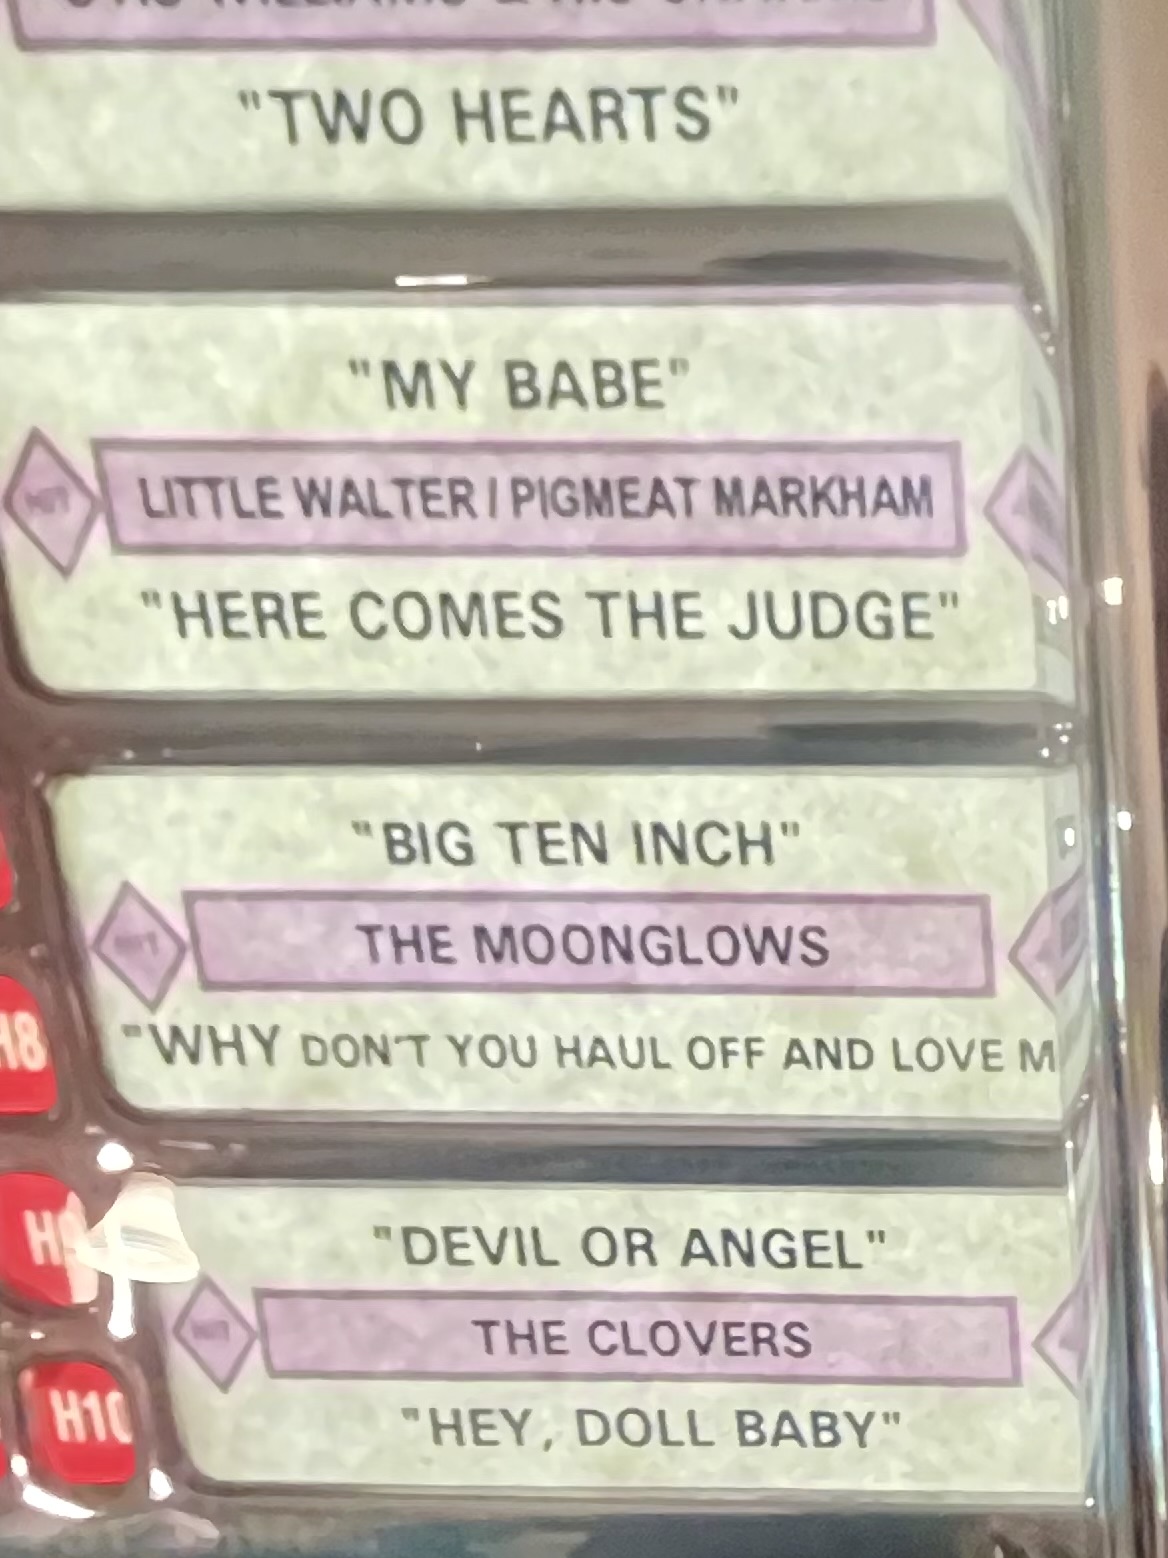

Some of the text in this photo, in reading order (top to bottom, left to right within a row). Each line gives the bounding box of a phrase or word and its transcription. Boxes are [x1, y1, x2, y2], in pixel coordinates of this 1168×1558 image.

[239, 85, 738, 146] "TWO HEARTS"
[348, 358, 691, 411] "MY BABE"
[138, 475, 285, 520] LITTLE
[292, 476, 478, 520] WALTER
[510, 476, 698, 519] PIGMEAT
[712, 474, 934, 519] MARKHAM
[141, 590, 958, 641] "HERE COMES THE JUDGE"
[352, 820, 800, 867] "BIG TEN INCH"
[354, 923, 830, 968] THE MOONGLOWS
[0, 1008, 51, 1072] H8
[123, 1023, 1056, 1073] "WHY DON'T YOU HAUL OFF AND LOVE M
[374, 1225, 885, 1270] "DEVIL OR ANGEL"
[471, 1319, 812, 1359] THE CLOVERS
[401, 1407, 900, 1452] "HEY, DOLL BABY"
